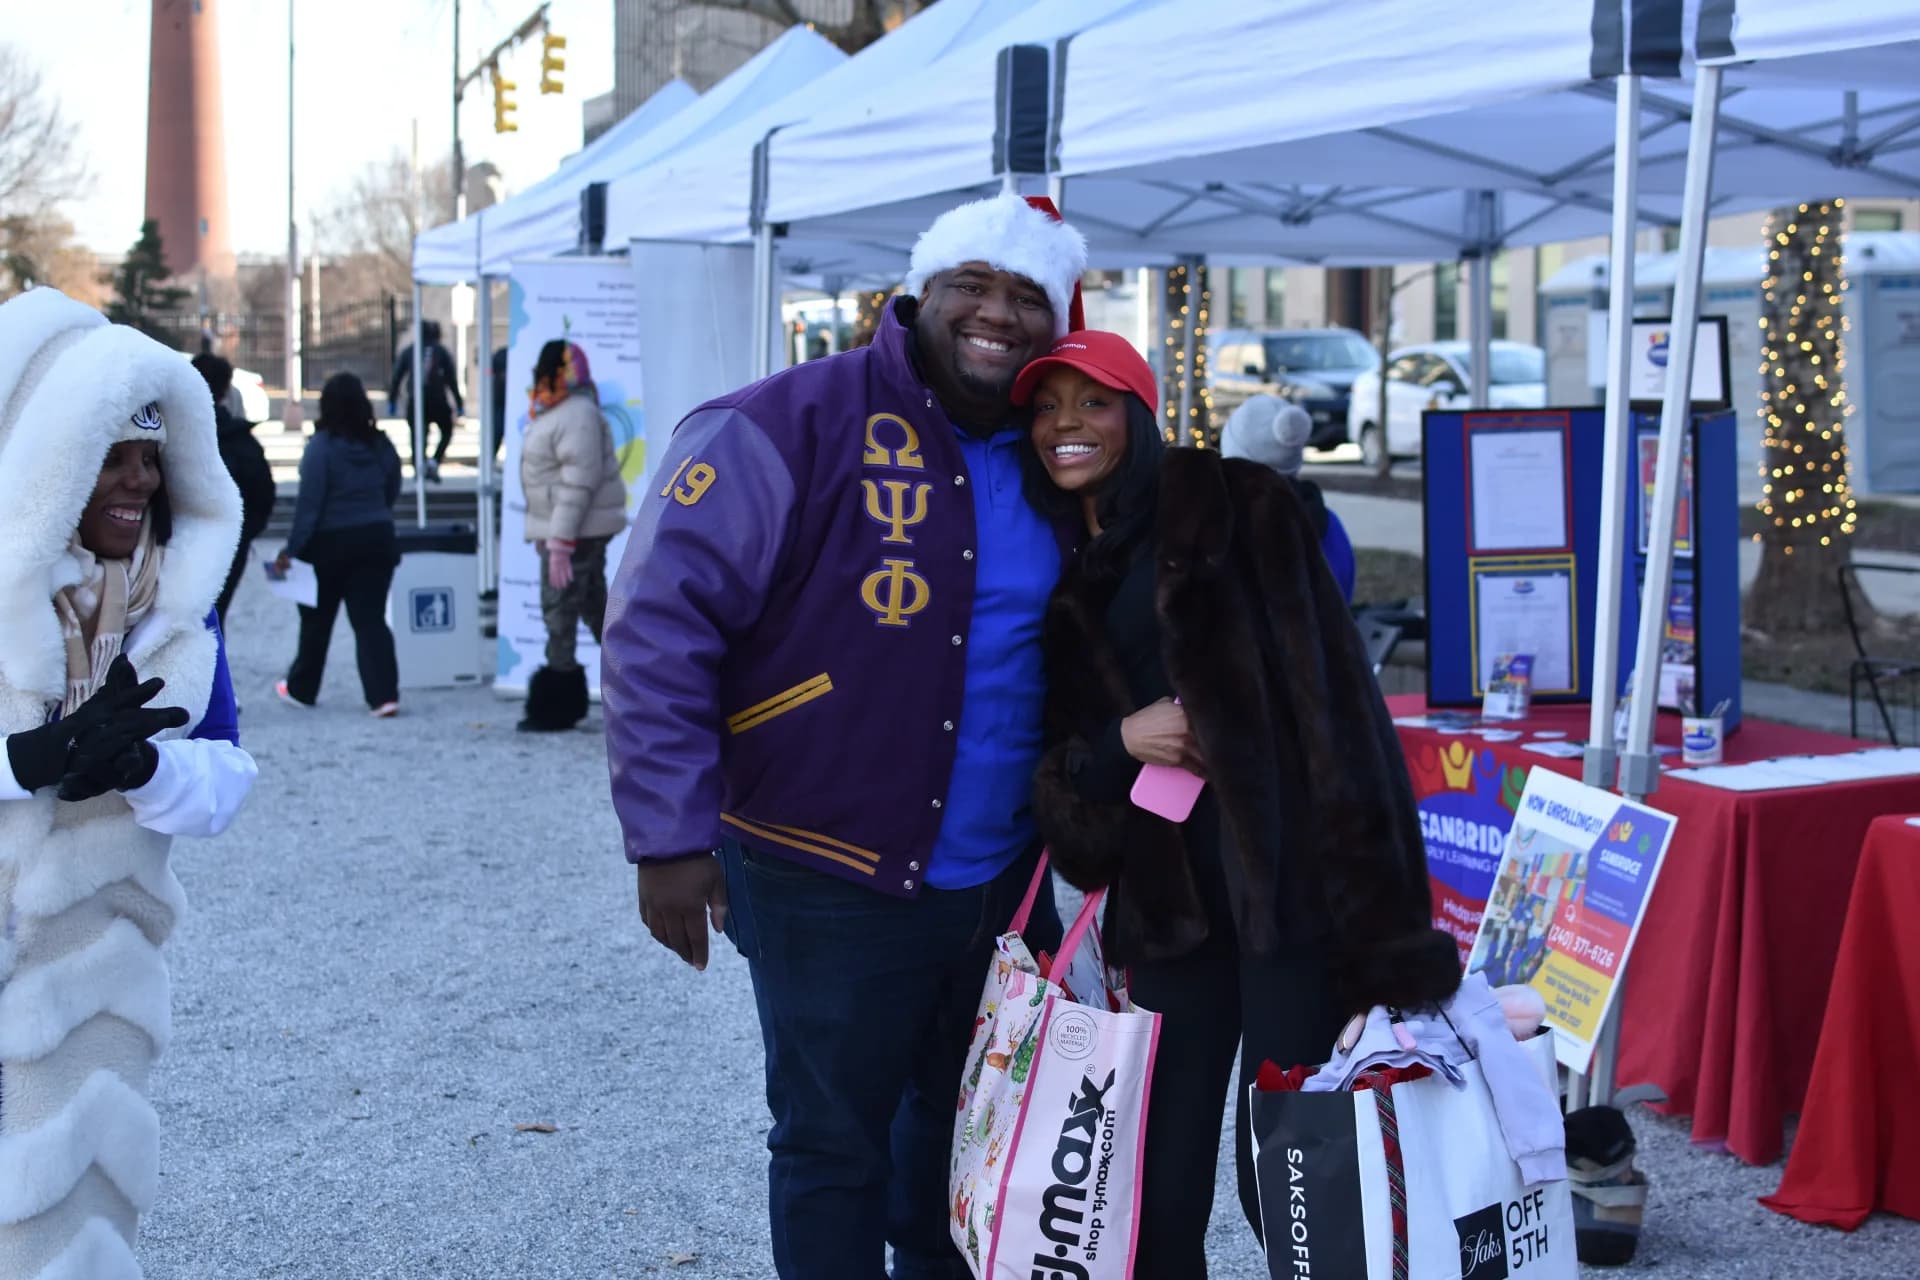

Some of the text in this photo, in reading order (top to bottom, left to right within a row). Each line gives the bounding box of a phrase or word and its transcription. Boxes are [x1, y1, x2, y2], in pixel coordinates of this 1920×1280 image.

[659, 455, 718, 507] 19
[1526, 793, 1546, 814] NOW
[1060, 1033, 1089, 1041] RECYCLED
[1060, 1039, 1087, 1048] MATERIAL
[1066, 1025, 1088, 1035] 100%
[1506, 1189, 1544, 1232] OFF
[1083, 1217, 1105, 1261] shop
[1461, 1228, 1502, 1279] Saks
[1512, 1224, 1549, 1269] 5TH
